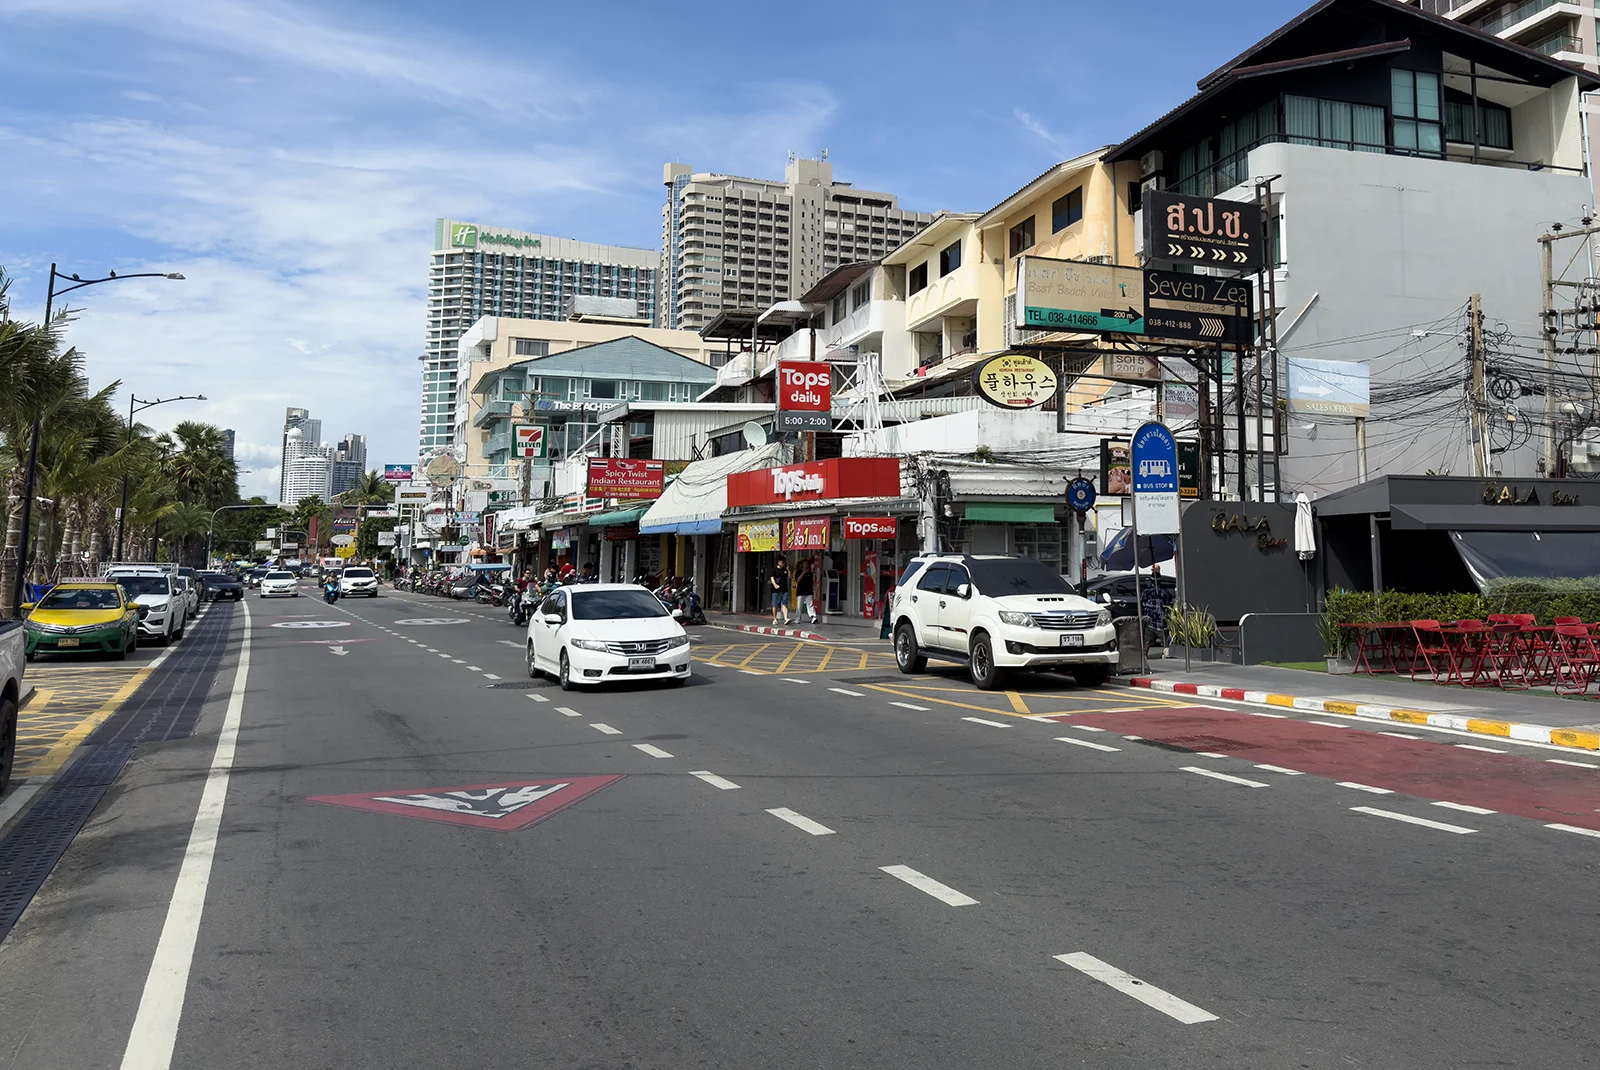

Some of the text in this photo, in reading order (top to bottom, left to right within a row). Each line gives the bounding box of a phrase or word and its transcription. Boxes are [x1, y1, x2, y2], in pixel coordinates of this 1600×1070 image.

[1166, 202, 1250, 240] ส.ป.ช.
[480, 231, 541, 248] Holiday Inn
[1028, 281, 1112, 300] Best Beach Villa
[1148, 273, 1247, 305] Seven Zea
[1028, 309, 1098, 326] TEL. 038-414666
[1114, 311, 1125, 319] 200
[1148, 318, 1192, 329] 038-412-888
[1115, 355, 1136, 364] SOI
[1116, 364, 1135, 372] 200
[781, 368, 830, 390] Tops
[983, 373, 1055, 391] 풀하우스
[553, 401, 571, 410] The
[790, 390, 821, 406] daily
[1305, 402, 1355, 413] SALES OFFICE
[784, 416, 803, 425] 5:00
[809, 417, 827, 425] 2:00
[605, 470, 648, 478] Spicy Twist
[618, 477, 660, 486] Restaurant
[771, 467, 804, 500] Tops
[847, 521, 896, 535] Tops daily
[1212, 512, 1271, 532] GALA
